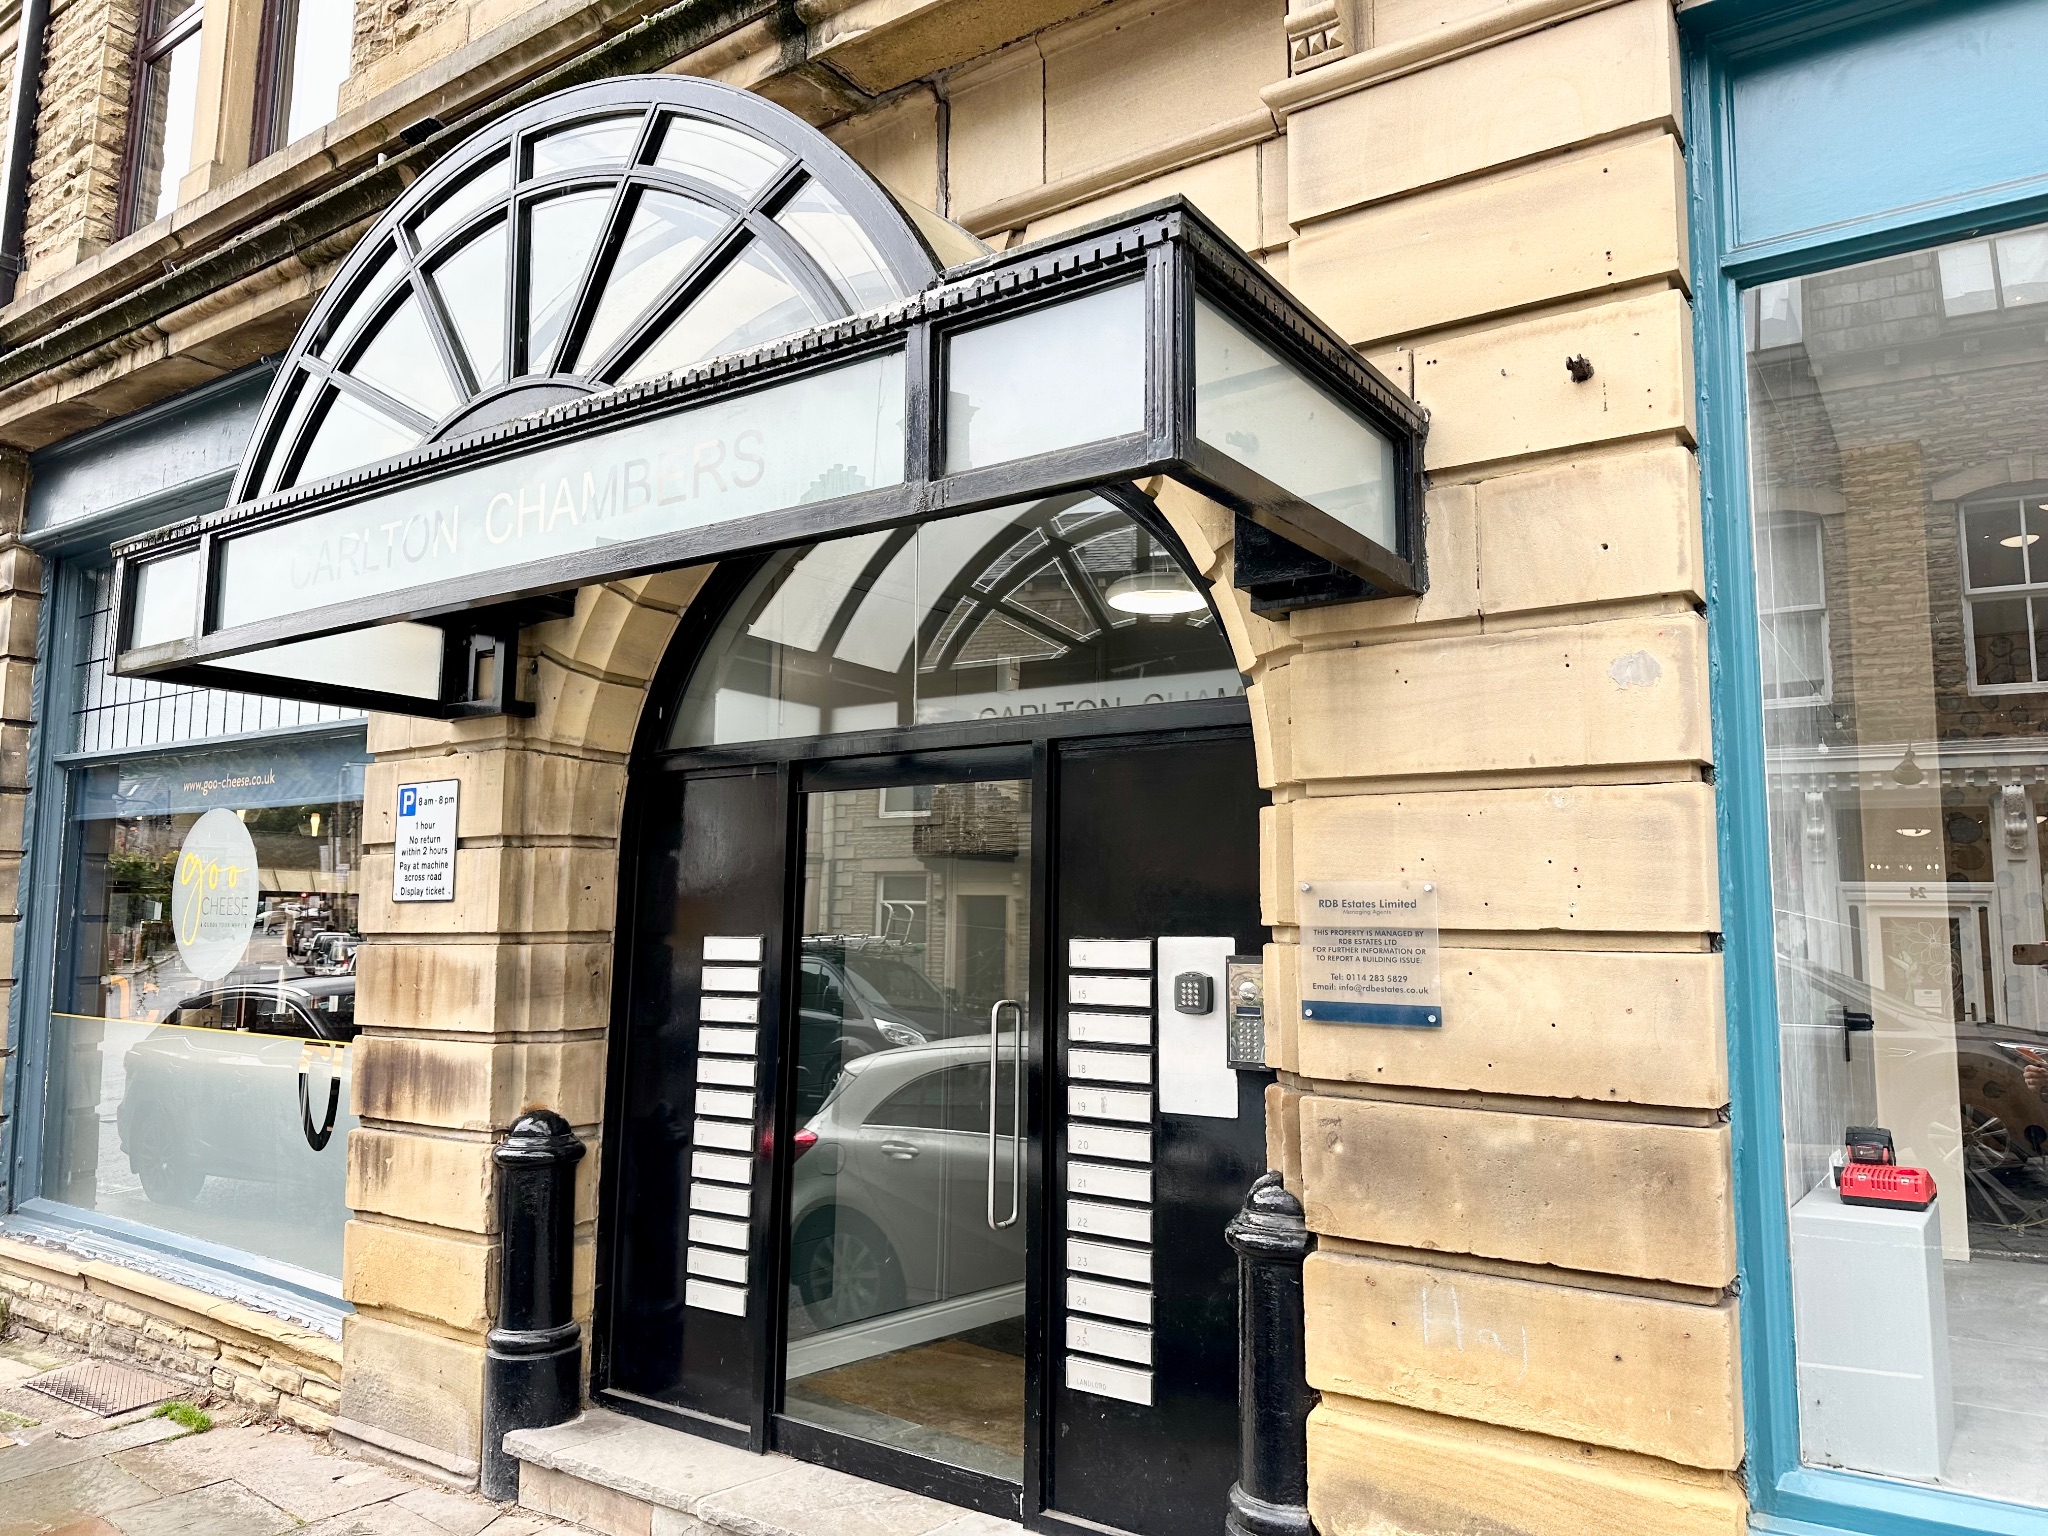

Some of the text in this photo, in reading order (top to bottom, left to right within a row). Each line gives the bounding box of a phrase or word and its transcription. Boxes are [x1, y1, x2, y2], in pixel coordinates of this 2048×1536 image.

[290, 430, 765, 590] CARLTON CHAMBERS
[183, 768, 275, 796] www.goo-cheese.co.uk
[416, 821, 435, 830] 1 hour
[409, 836, 418, 844] No
[402, 846, 447, 856] within 2 hours
[400, 862, 410, 871] Pay
[422, 861, 448, 869] machine
[427, 872, 442, 881] road
[401, 887, 445, 897] Display ticket
[181, 852, 249, 946] goo
[1319, 900, 1416, 908] RDB Estates Limited
[202, 897, 248, 915] CHEESE
[1339, 984, 1429, 994] info@rdbestates.co.uk
[1078, 990, 1086, 999] 15
[1078, 1027, 1085, 1036] 17
[1078, 1064, 1086, 1073] 18
[1078, 1102, 1086, 1111] 19
[1078, 1140, 1088, 1150] 20
[1078, 1179, 1086, 1188] 21
[1078, 1218, 1088, 1228] 22
[1078, 1257, 1088, 1267] 23
[1077, 1296, 1087, 1306] 24
[1076, 1378, 1106, 1390] LANDLORD
